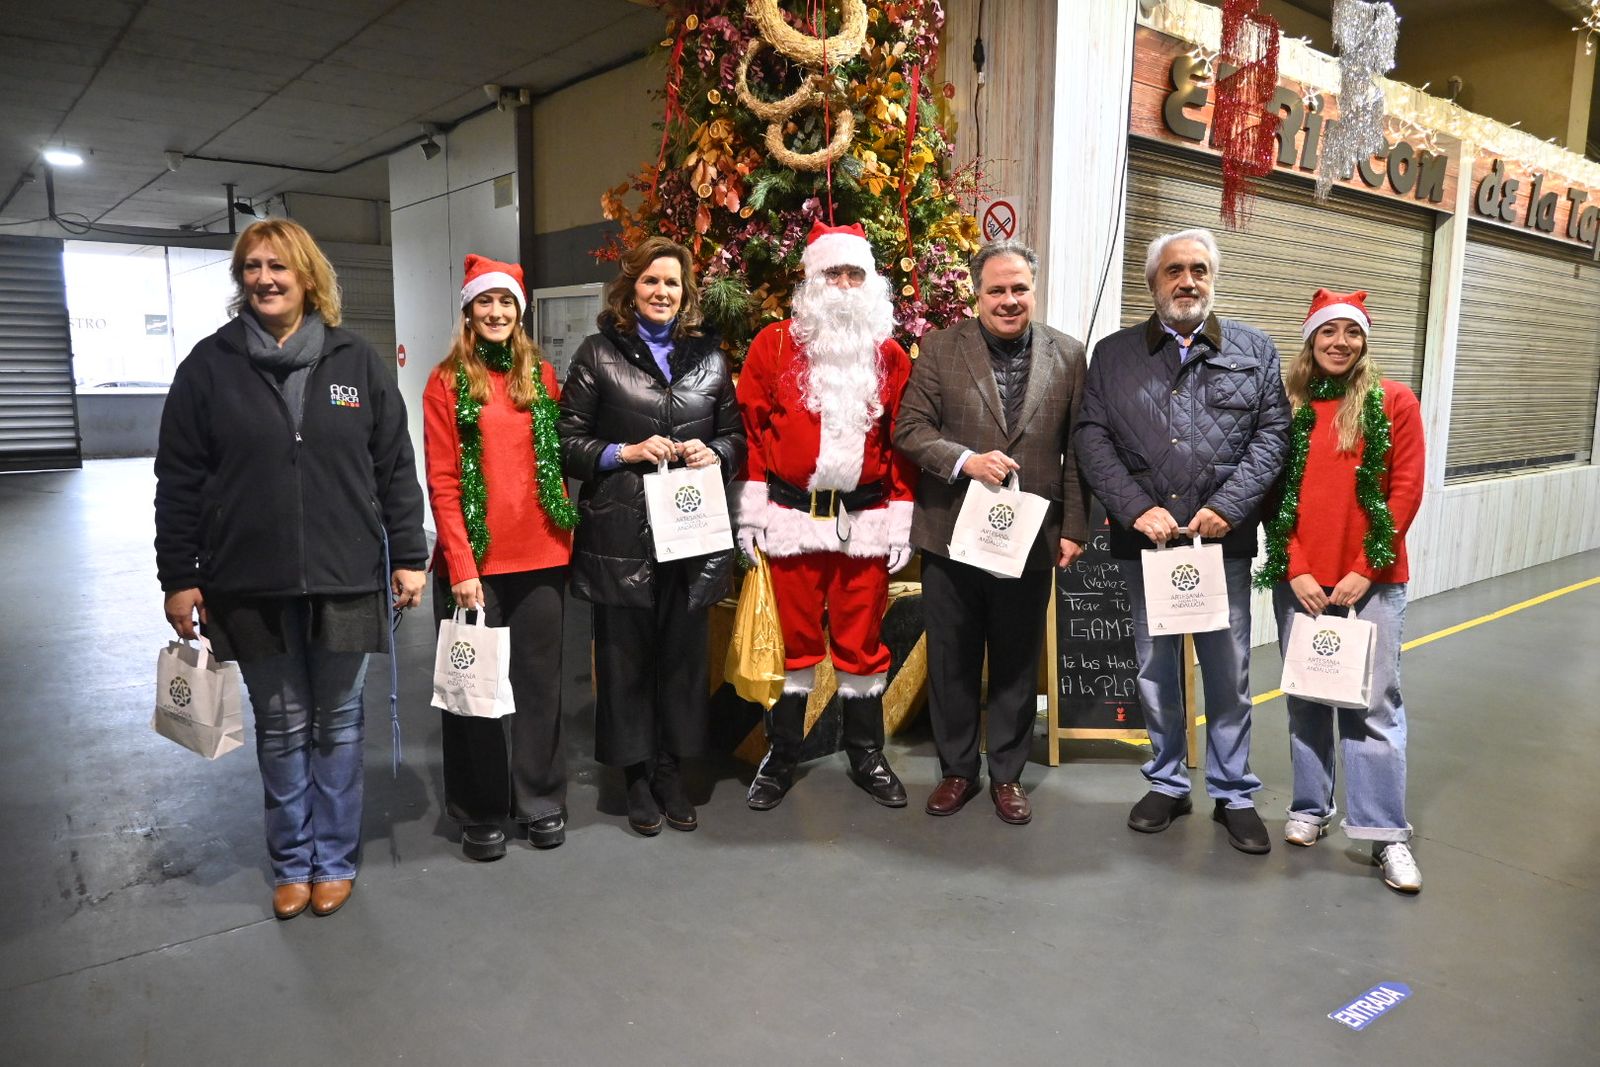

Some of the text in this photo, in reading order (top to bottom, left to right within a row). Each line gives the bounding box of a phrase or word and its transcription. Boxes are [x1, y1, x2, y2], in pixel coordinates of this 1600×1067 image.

[1475, 159, 1519, 222] de
[1526, 173, 1558, 233] la
[1333, 986, 1406, 1028] ENTRADA
